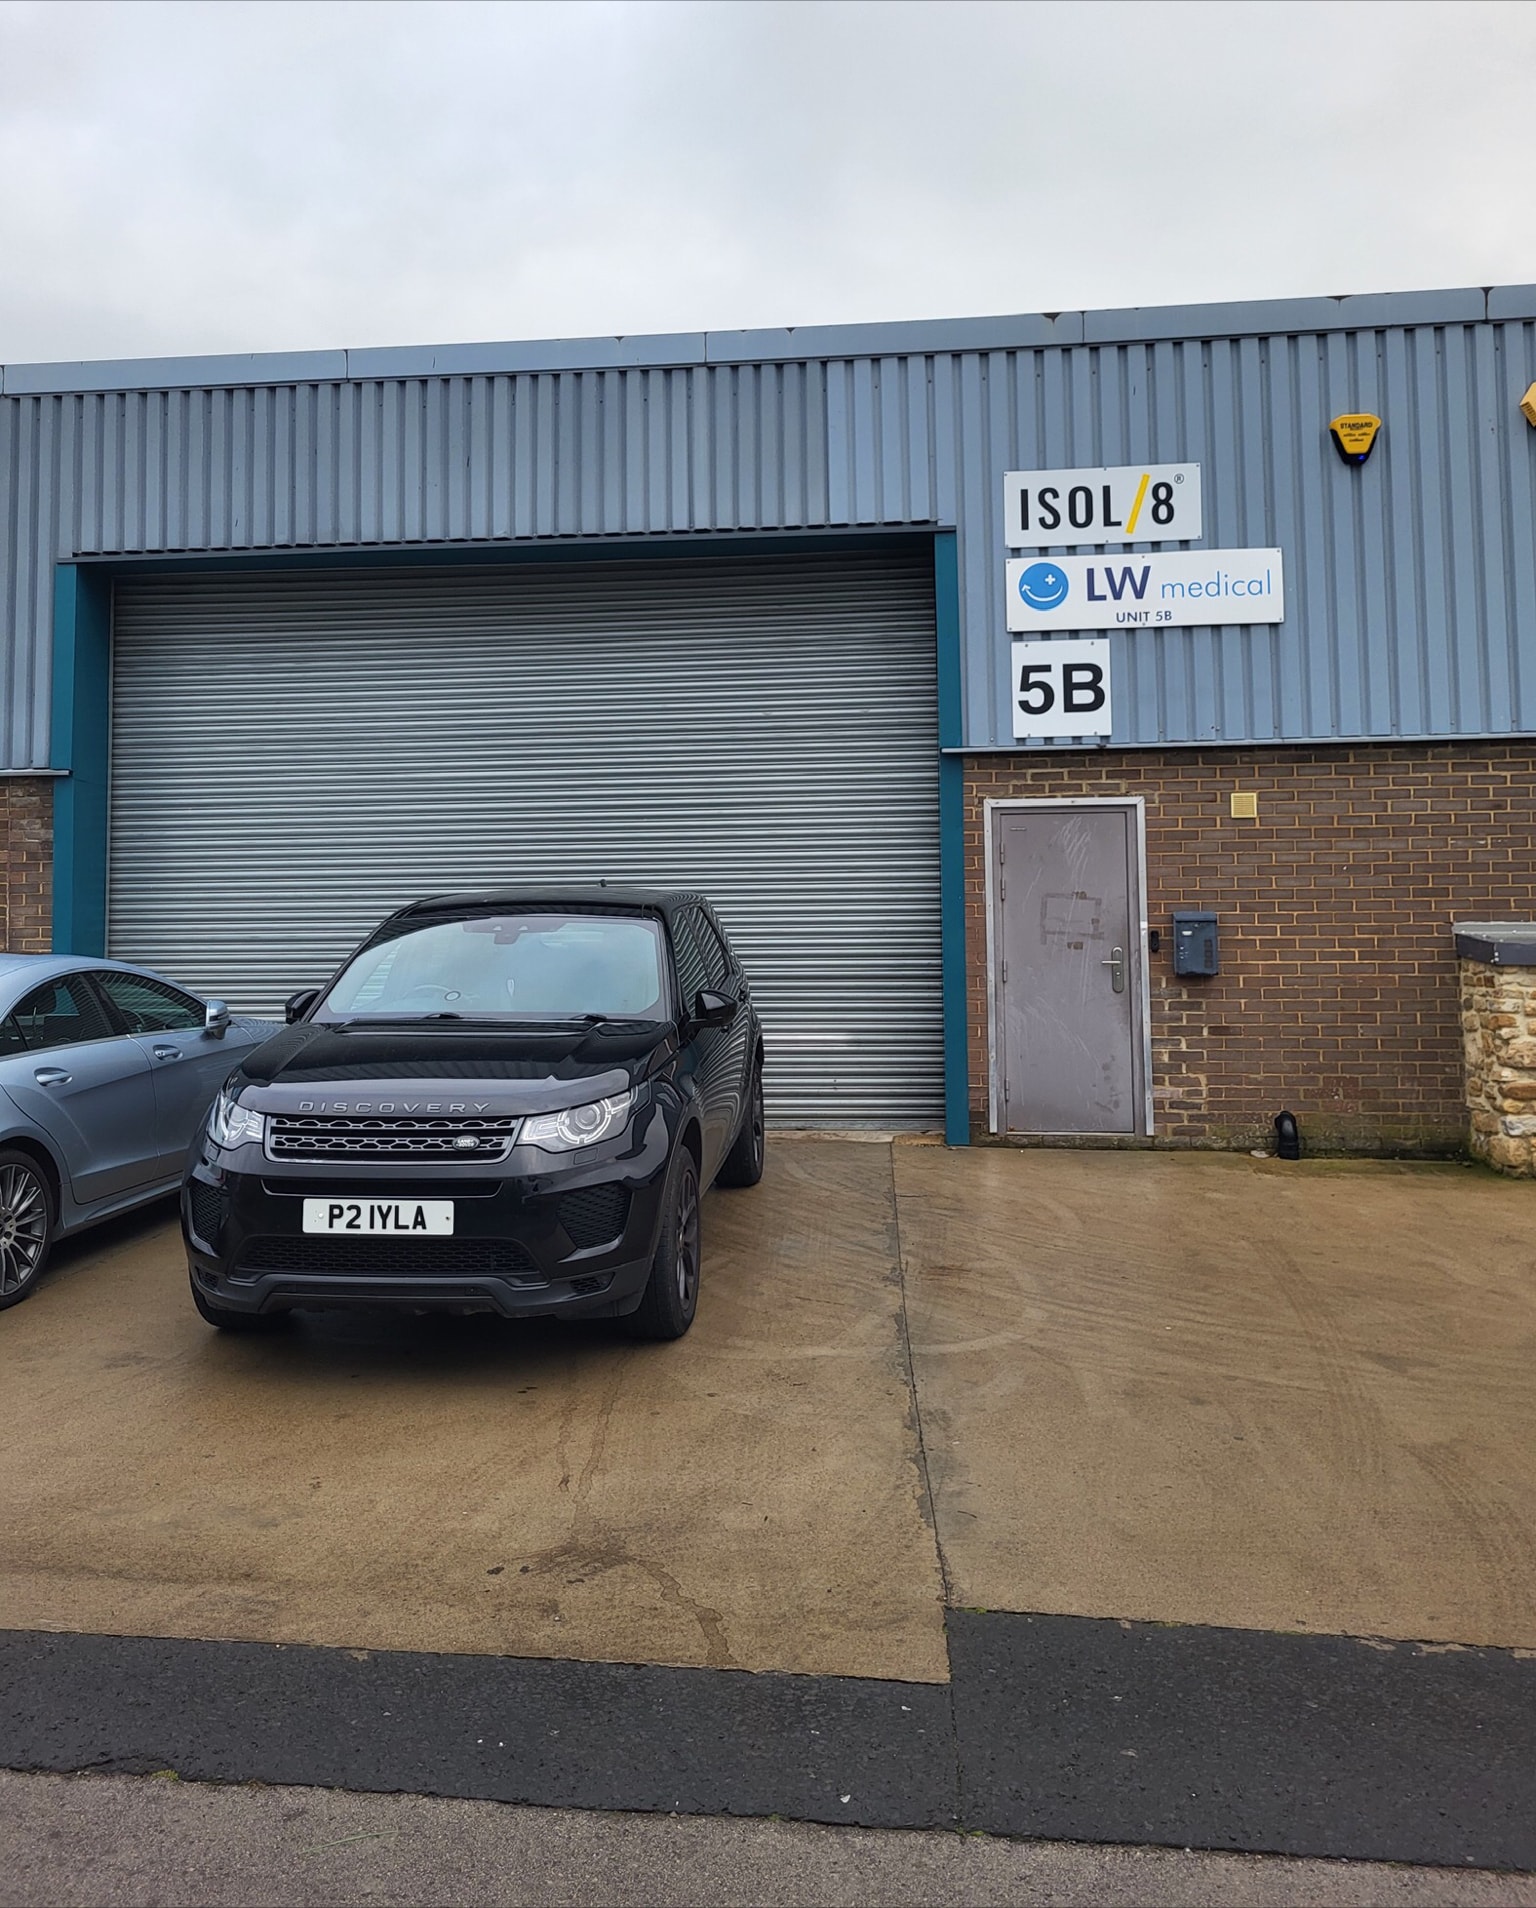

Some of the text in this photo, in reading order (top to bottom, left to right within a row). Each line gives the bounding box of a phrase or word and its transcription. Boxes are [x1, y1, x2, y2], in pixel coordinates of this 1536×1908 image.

[1086, 566, 1271, 601] LW medical
[1116, 610, 1173, 623] UNIT 5B
[1018, 663, 1105, 715] 5B
[299, 1101, 490, 1112] DISCOVERY
